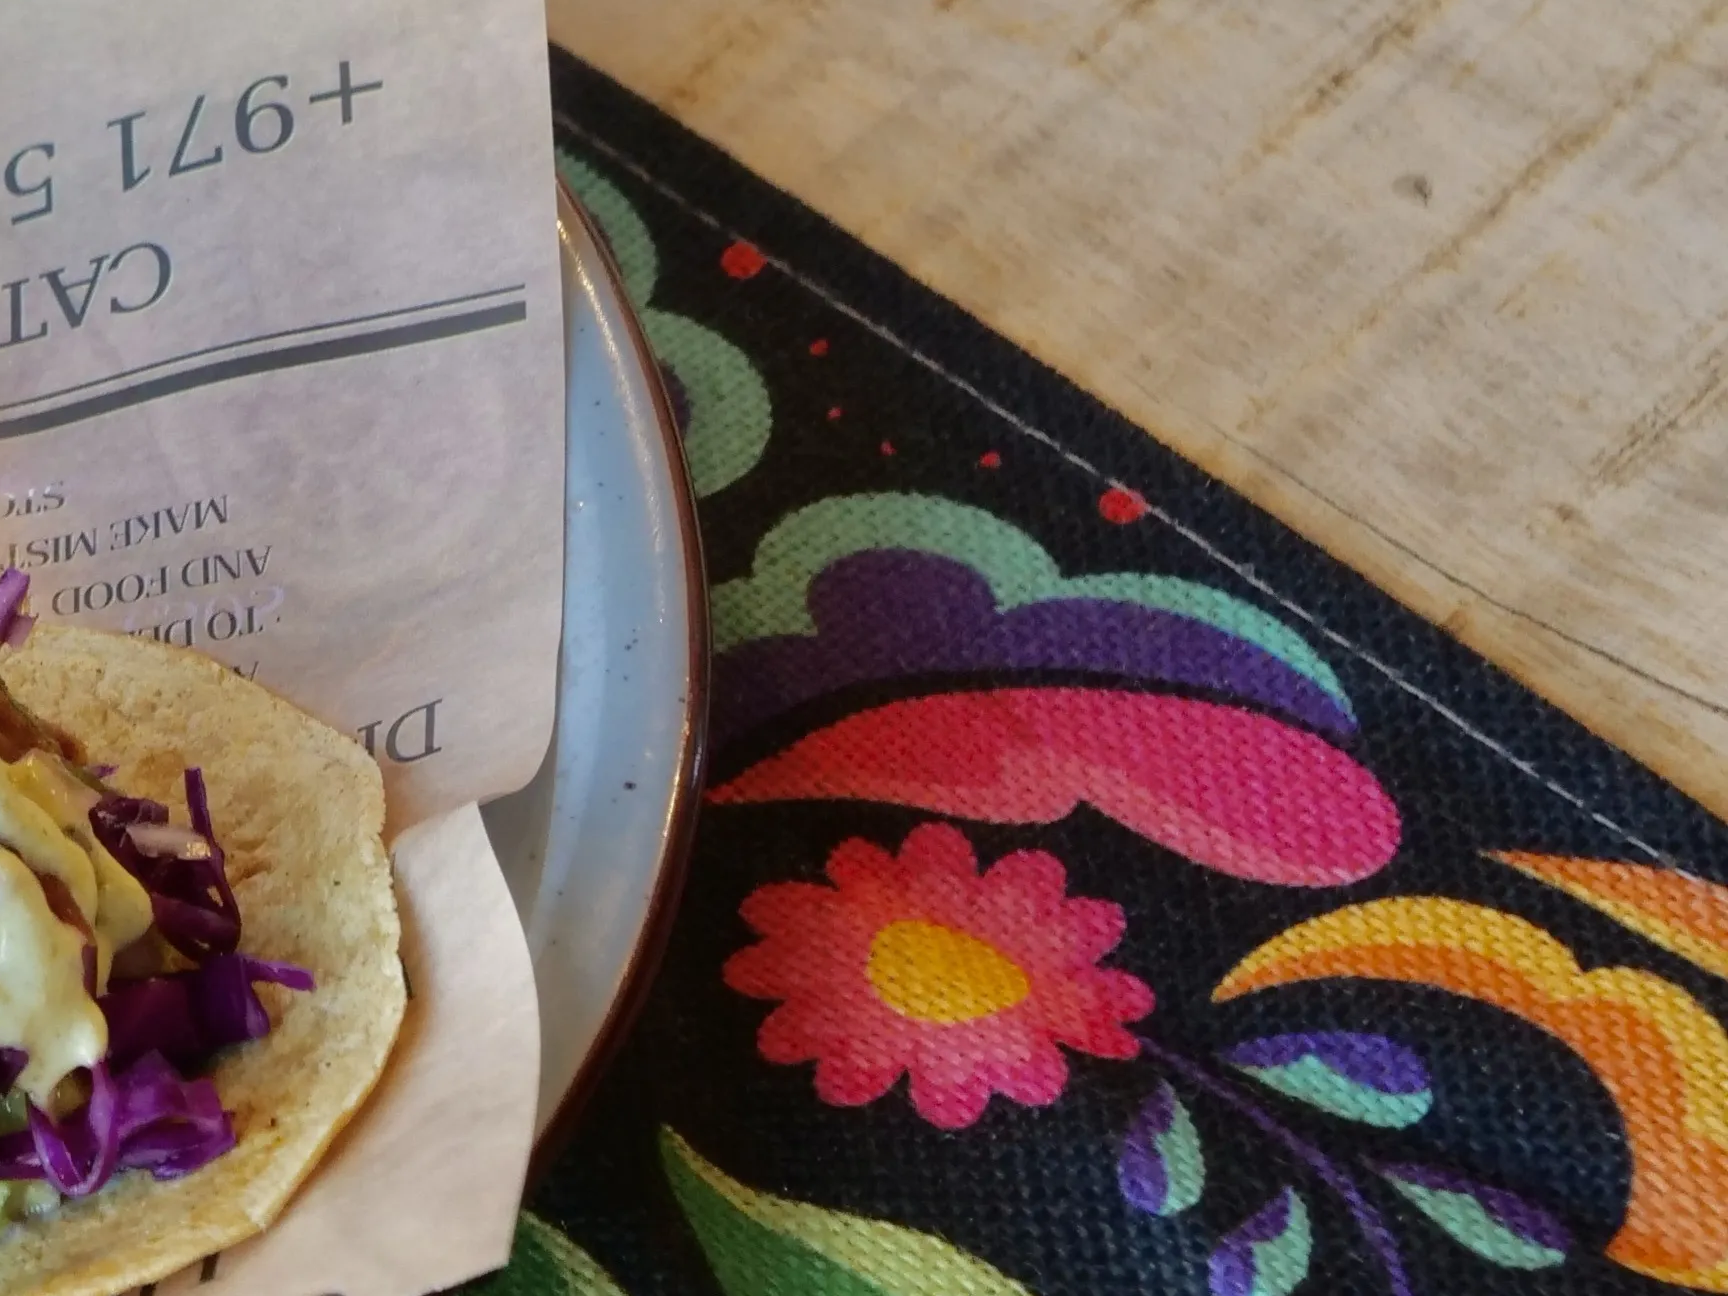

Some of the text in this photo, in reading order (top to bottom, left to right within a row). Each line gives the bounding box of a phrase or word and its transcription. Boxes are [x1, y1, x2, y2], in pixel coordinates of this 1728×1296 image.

[105, 59, 384, 191] +971
[109, 494, 229, 551] MAKE
[51, 564, 170, 617] FOOD
[180, 545, 272, 588] AND
[206, 606, 263, 641] TO
